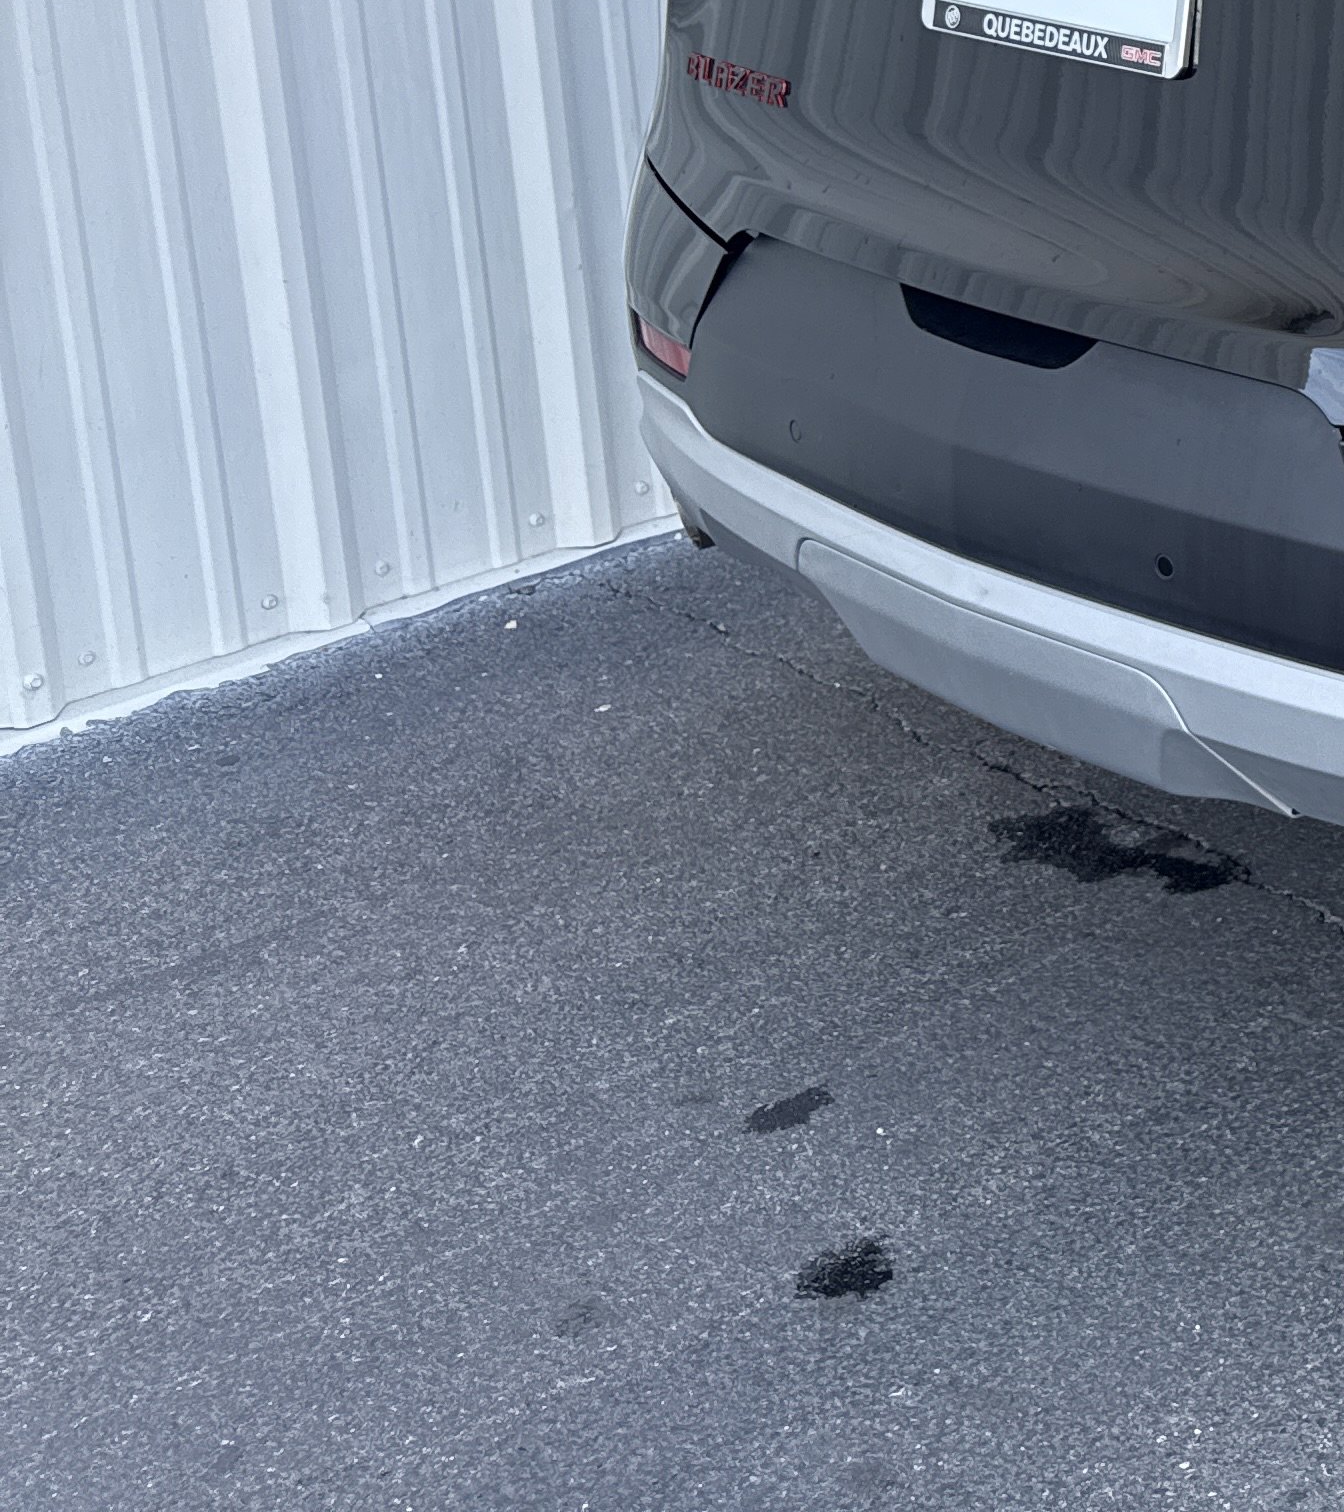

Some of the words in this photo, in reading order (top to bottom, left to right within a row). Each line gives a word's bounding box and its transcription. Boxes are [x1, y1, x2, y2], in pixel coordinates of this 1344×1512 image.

[982, 13, 1111, 59] QUEBEDEAUX
[1121, 44, 1162, 67] GMC
[687, 51, 792, 109] BLAZER
